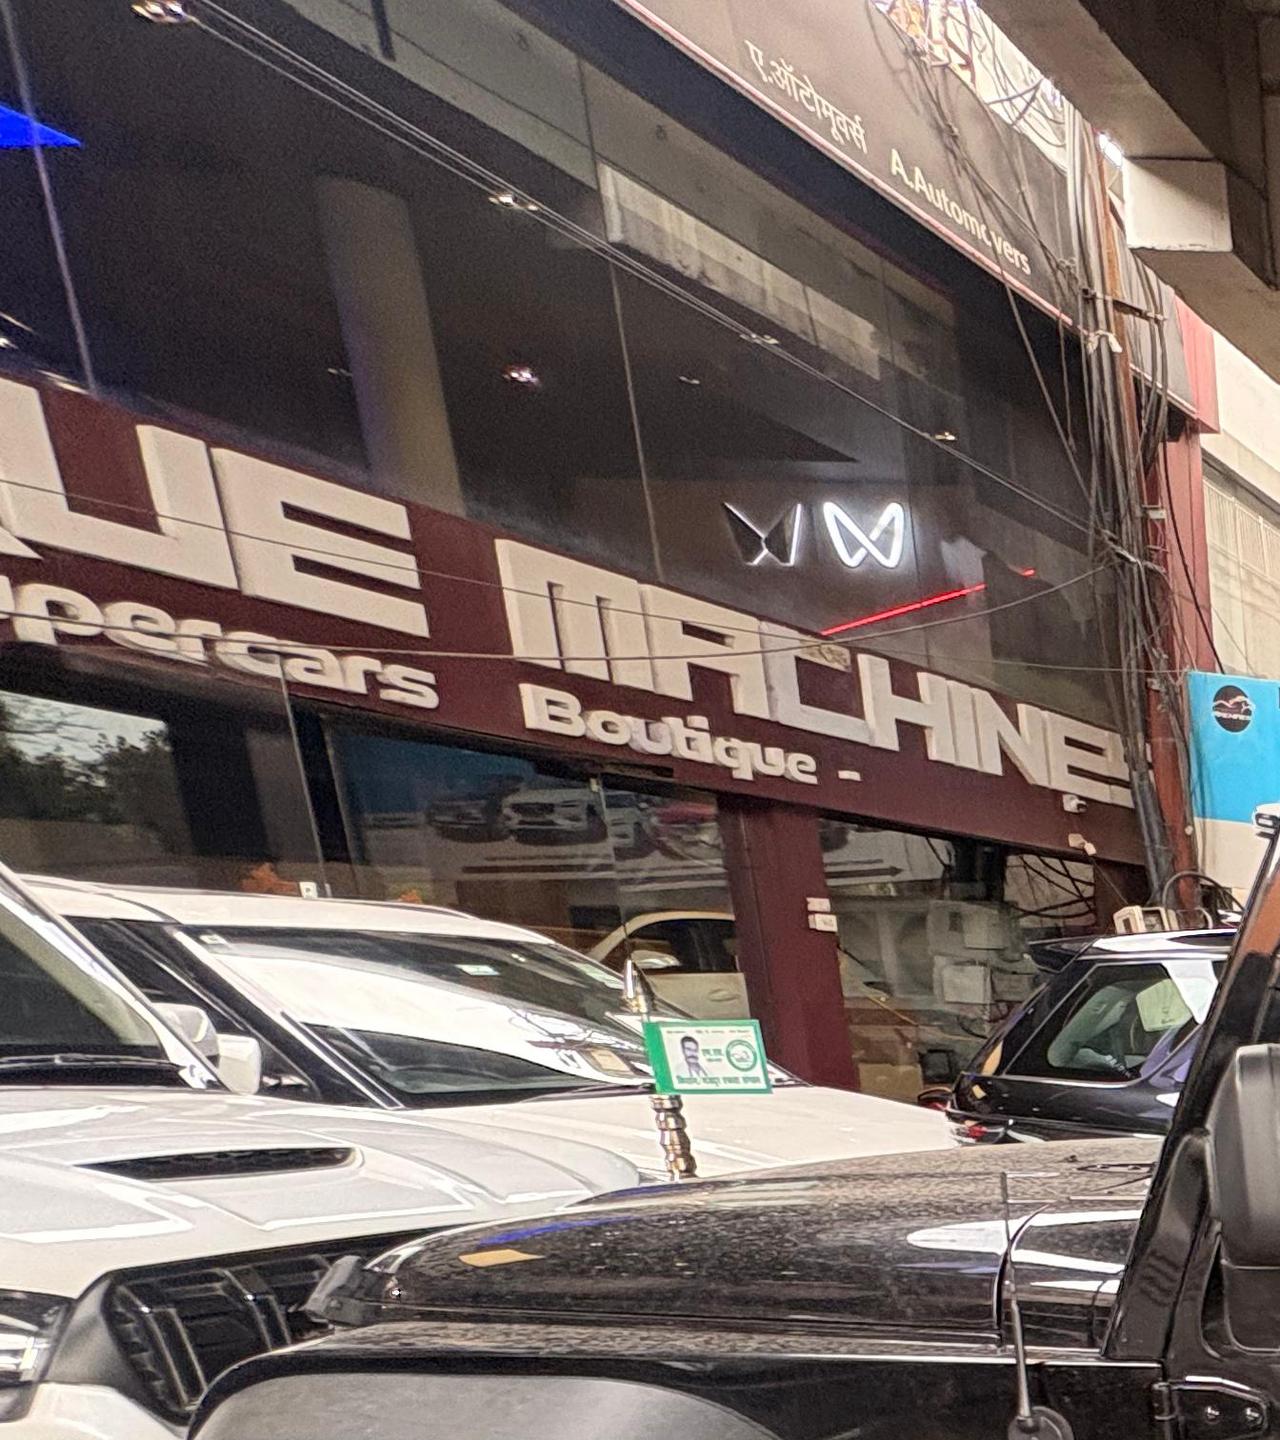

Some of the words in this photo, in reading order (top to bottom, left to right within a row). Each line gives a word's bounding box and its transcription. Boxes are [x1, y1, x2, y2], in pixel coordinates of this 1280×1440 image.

[0, 376, 431, 638] UE
[495, 538, 1151, 809] MACHINE
[518, 683, 818, 784] Boutique
